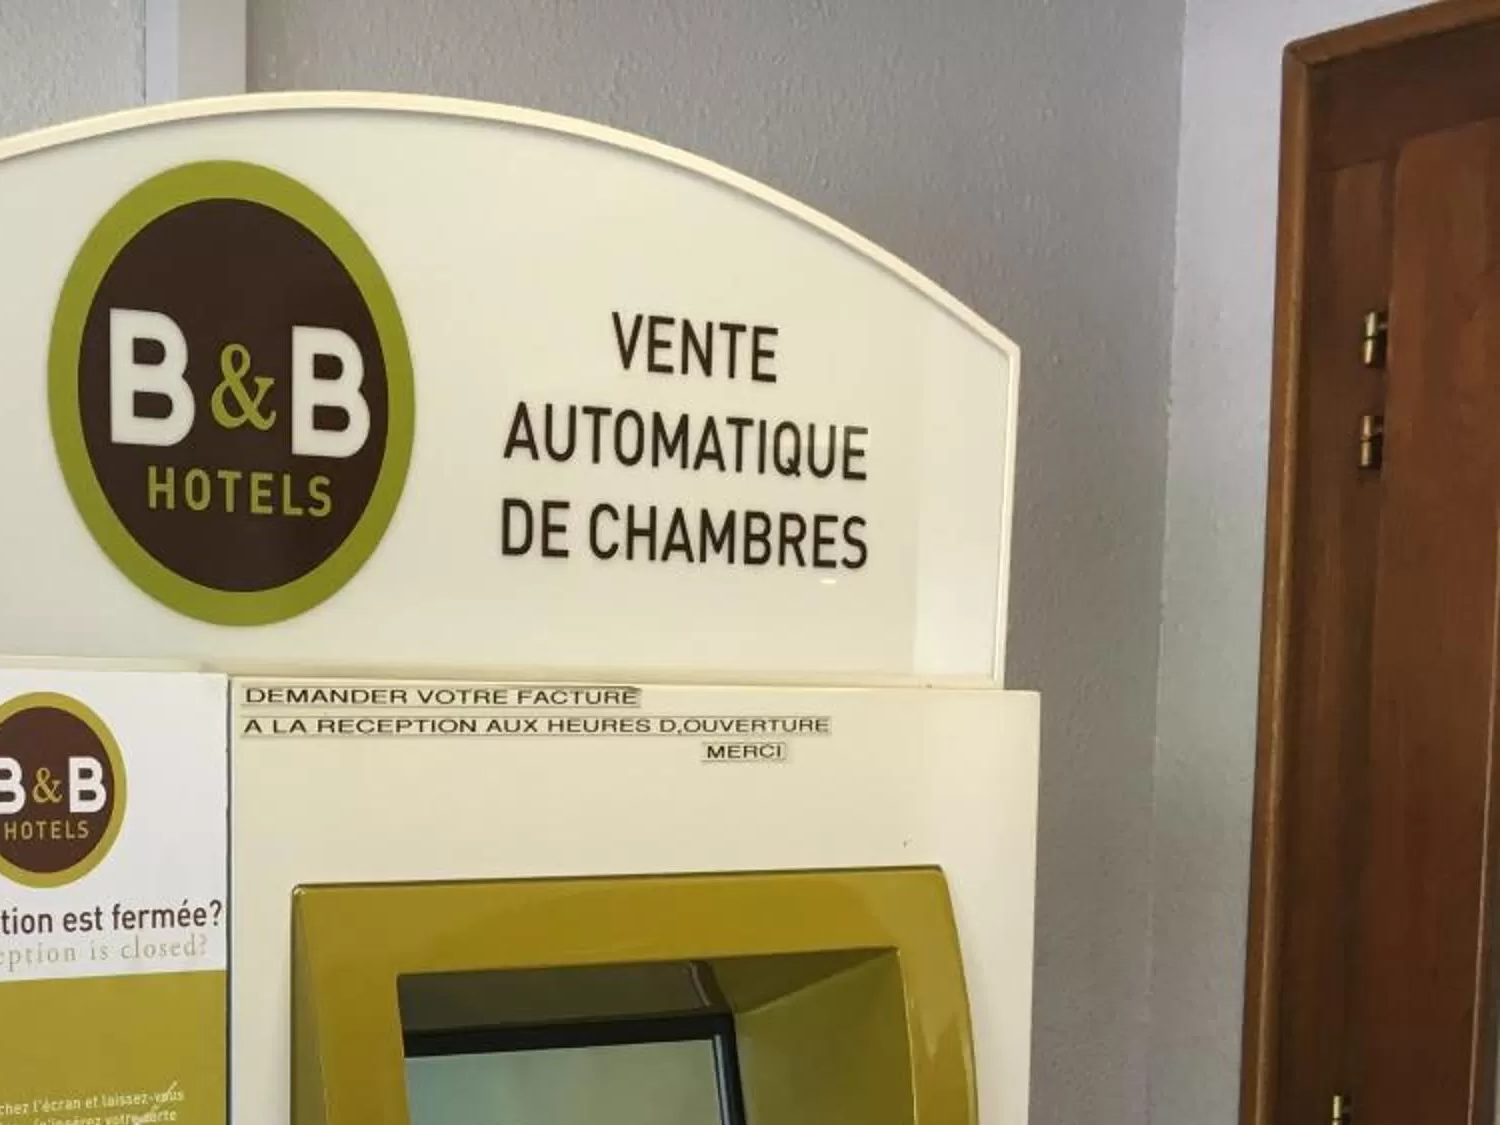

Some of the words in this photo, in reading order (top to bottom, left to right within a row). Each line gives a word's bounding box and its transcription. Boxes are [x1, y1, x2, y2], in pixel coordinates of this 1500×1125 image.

[612, 311, 779, 383] VENTE
[504, 401, 869, 483] AUTOMATIQUE
[147, 465, 333, 517] HOTELS
[502, 499, 571, 558] DE
[588, 503, 869, 570] CHAMBRES
[245, 688, 408, 704] DEMANDER
[416, 689, 508, 705] VOTRE
[517, 689, 636, 705] FACTURE
[244, 718, 262, 734] A
[272, 718, 306, 734] LA
[317, 718, 478, 734] RECEPTION
[486, 718, 538, 734] AUX
[548, 718, 650, 734] HEURES
[707, 744, 782, 759] MERCI
[4, 821, 89, 839] HOTELS
[63, 907, 103, 932] est
[112, 900, 221, 930] fermée?
[91, 944, 108, 960] is
[121, 934, 207, 959] closed?
[86, 1096, 98, 1108] et
